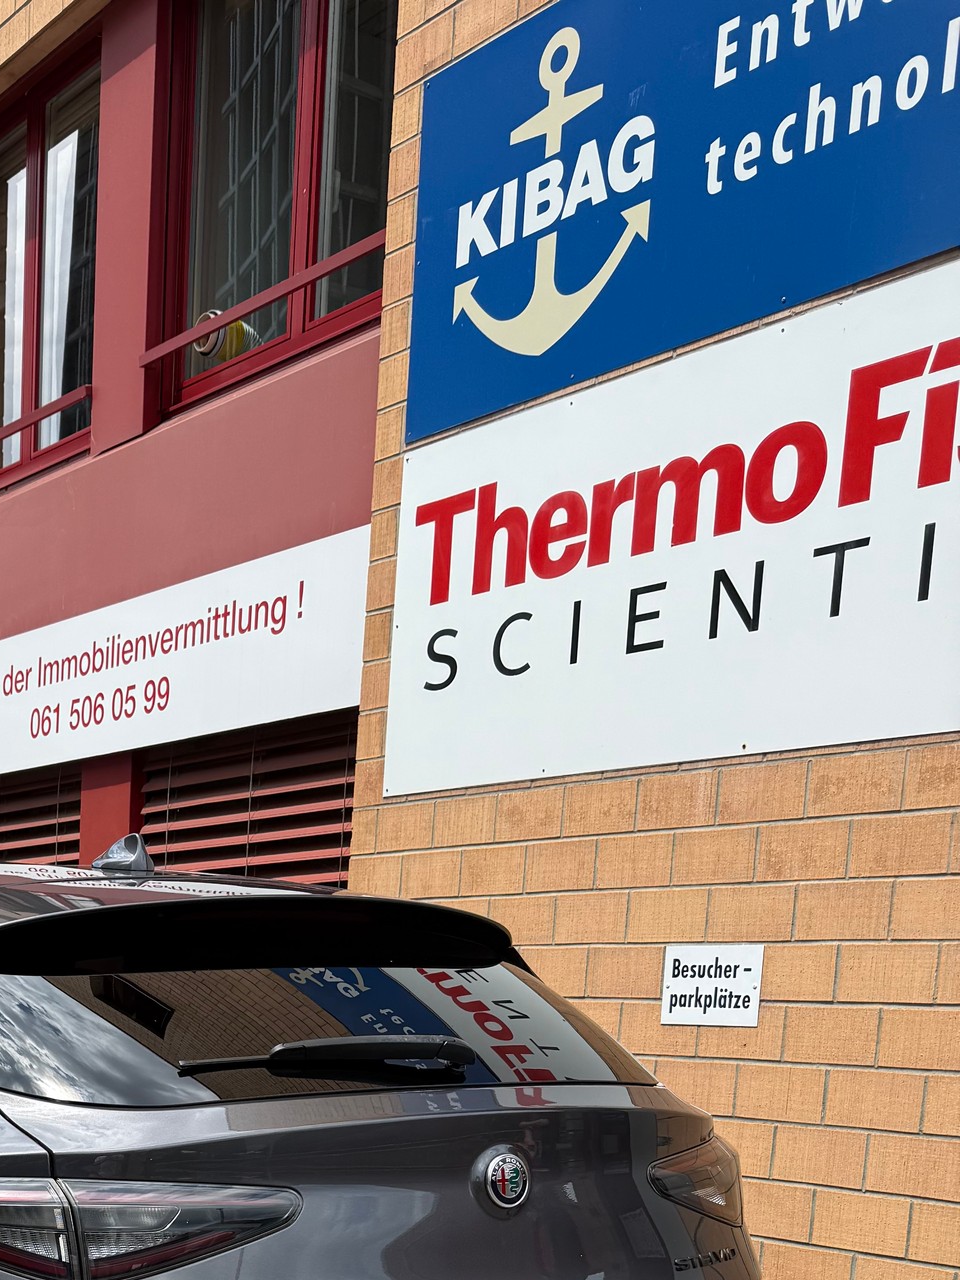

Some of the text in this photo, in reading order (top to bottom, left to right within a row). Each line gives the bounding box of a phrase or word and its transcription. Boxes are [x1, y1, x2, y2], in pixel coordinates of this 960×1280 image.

[705, 16, 960, 195] technol
[714, 0, 893, 89] Entw
[455, 115, 656, 269] KIBAG
[415, 337, 960, 606] ThermoFi
[2, 664, 33, 696] der
[38, 594, 288, 688] Immobilienvermittlung
[423, 522, 936, 691] SCIENTI
[30, 676, 171, 739] 061 506 05 99
[669, 986, 751, 1014] parkplätze
